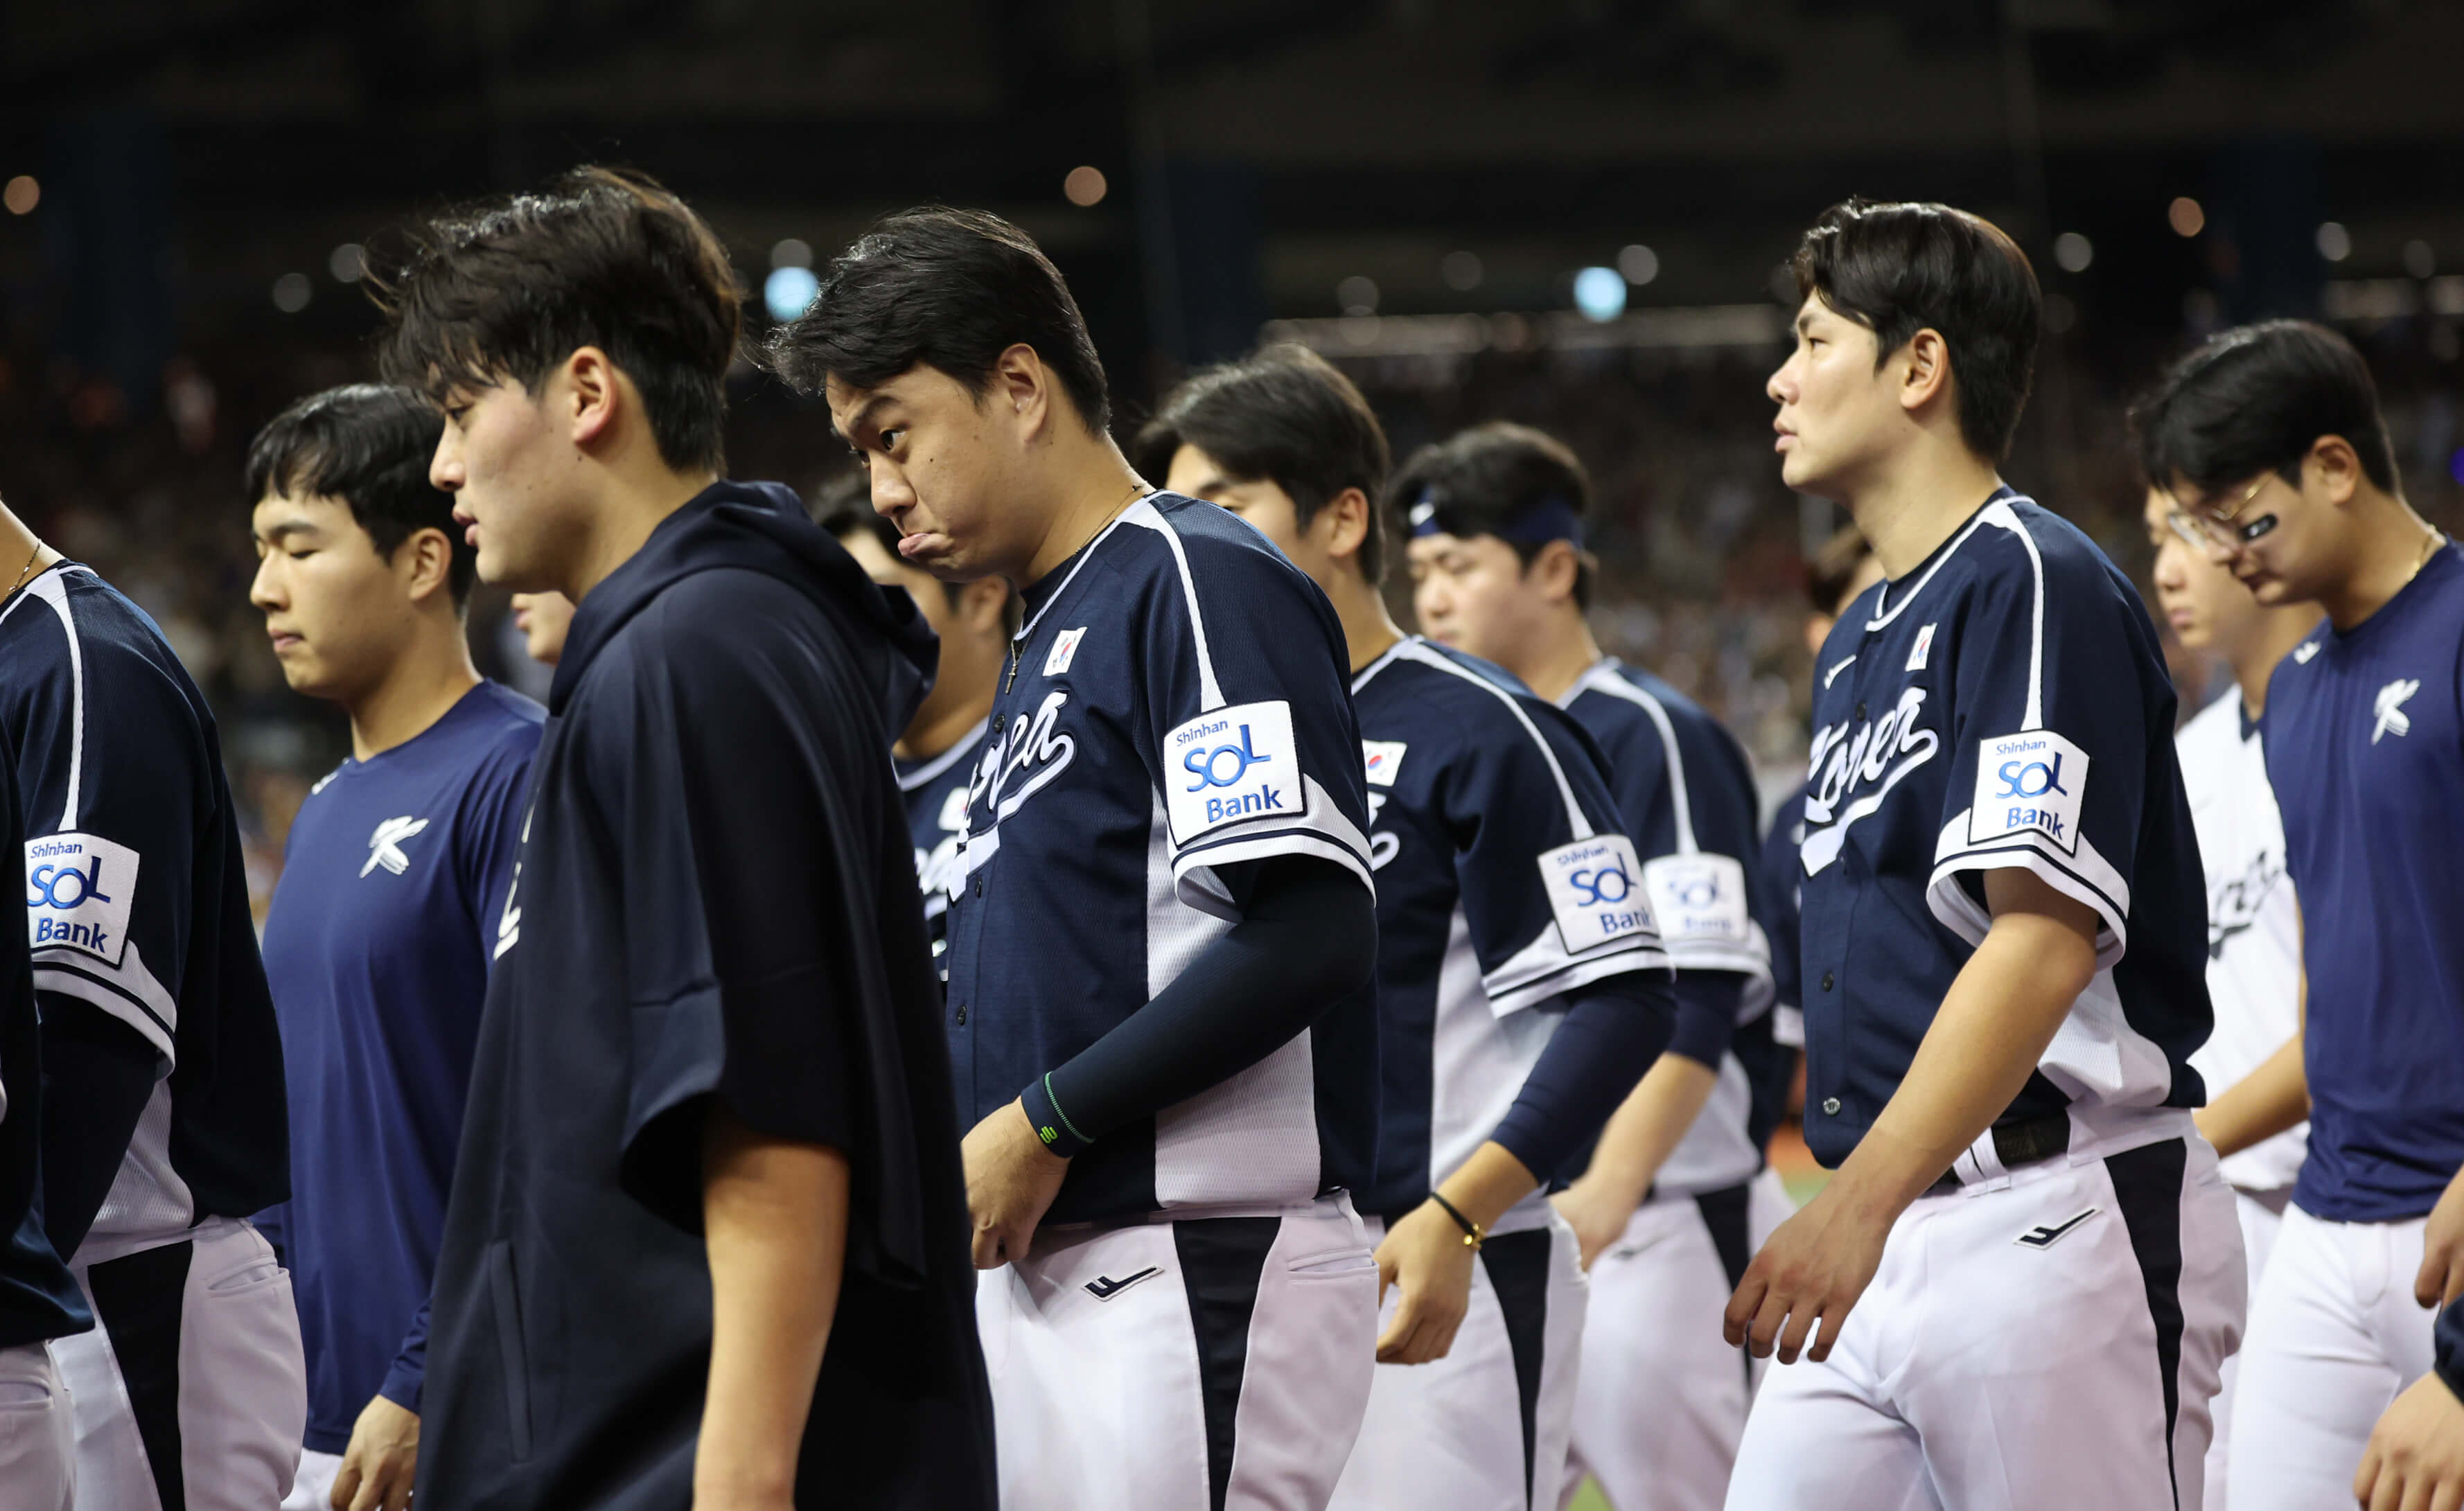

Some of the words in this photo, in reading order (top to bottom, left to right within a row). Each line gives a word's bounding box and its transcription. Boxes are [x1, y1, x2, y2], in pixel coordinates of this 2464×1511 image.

[1177, 720, 1229, 747] Shinhan
[1996, 739, 2047, 756] Shinhan
[1183, 724, 1271, 793] SOL
[1995, 752, 2068, 799] SOL
[1206, 784, 1283, 824] Bank
[2007, 806, 2064, 840] Bank
[30, 842, 82, 858] Shinhan
[28, 856, 111, 909] SOL
[1570, 851, 1637, 907] SOL
[36, 917, 108, 953] Bank
